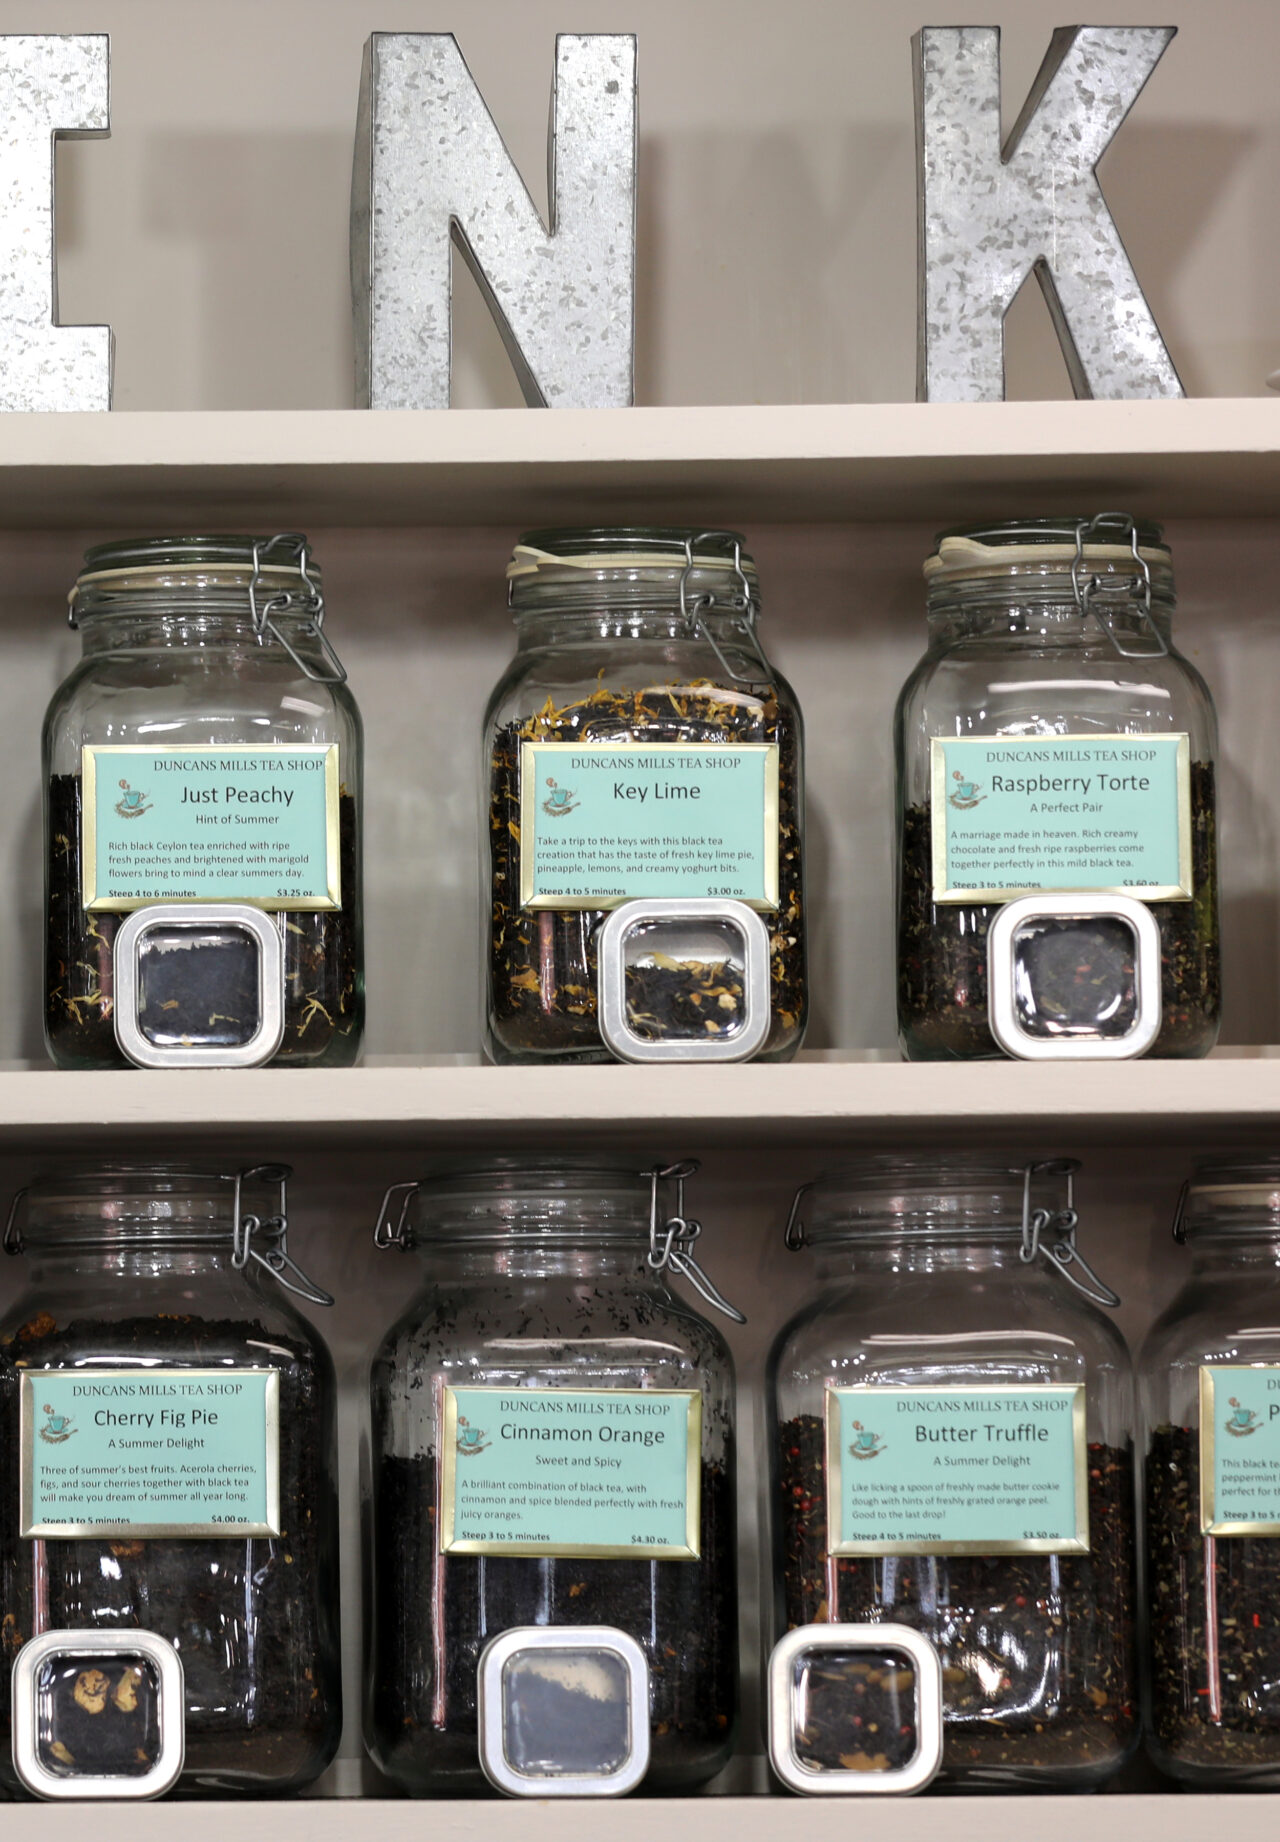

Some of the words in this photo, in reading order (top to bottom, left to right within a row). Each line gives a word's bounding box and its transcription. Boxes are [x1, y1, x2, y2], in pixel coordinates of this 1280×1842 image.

[987, 751, 1050, 762] DUNCANS
[1053, 750, 1091, 761] MILLS
[1093, 750, 1118, 761] TEA
[1121, 750, 1157, 761] SHOP
[154, 760, 217, 771] DUNCANS
[220, 760, 257, 771] MILLS
[259, 760, 284, 771] TEA
[287, 760, 323, 771] SHOP
[571, 758, 634, 769] DUNCANS
[638, 758, 675, 769] MILLS
[677, 758, 702, 768] TEA
[705, 758, 741, 768] SHOP
[992, 774, 1091, 796] Raspberry
[1096, 774, 1150, 791] Torte
[181, 786, 218, 803] Just
[226, 785, 294, 807] Peachy
[614, 783, 648, 803] Key
[655, 782, 701, 799] Lime
[1030, 803, 1038, 813] A
[1041, 802, 1079, 813] Perfect
[1082, 802, 1103, 812] Pair
[196, 814, 218, 824] Hint
[221, 814, 232, 824] of
[235, 814, 279, 824] Summer
[109, 841, 128, 851] Rich
[130, 841, 154, 851] black
[156, 841, 187, 852] Ceylon
[189, 842, 205, 850] tea
[207, 841, 247, 850] enriched
[249, 841, 269, 850] with
[272, 842, 290, 852] ripe
[707, 887, 732, 896] $3.00
[73, 1385, 136, 1397] DUNCANS
[139, 1385, 176, 1396] MILLS
[178, 1385, 204, 1396] TEA
[207, 1384, 242, 1395] SHOP
[500, 1400, 563, 1413] DUNCANS
[567, 1402, 604, 1414] MILLS
[607, 1403, 631, 1415] TEA
[635, 1404, 670, 1415] SHOP
[897, 1401, 961, 1412] DUNCANS
[964, 1401, 1002, 1412] MILLS
[1004, 1400, 1029, 1412] TEA
[1032, 1400, 1068, 1411] SHOP
[94, 1409, 154, 1428] Cherry
[161, 1409, 186, 1428] Fig
[192, 1409, 218, 1425] Pie
[501, 1423, 592, 1441] Cinnamon
[599, 1426, 665, 1447] Orange
[916, 1425, 977, 1442] Butter
[984, 1423, 1049, 1442] Truffle
[108, 1439, 116, 1448] A
[119, 1439, 163, 1448] Summer
[167, 1437, 204, 1450] Delight
[536, 1455, 568, 1466] Sweet
[571, 1456, 591, 1466] and
[594, 1456, 622, 1469] Spicy
[933, 1456, 942, 1466] A
[944, 1456, 989, 1466] Summer
[992, 1455, 1031, 1468] Delight
